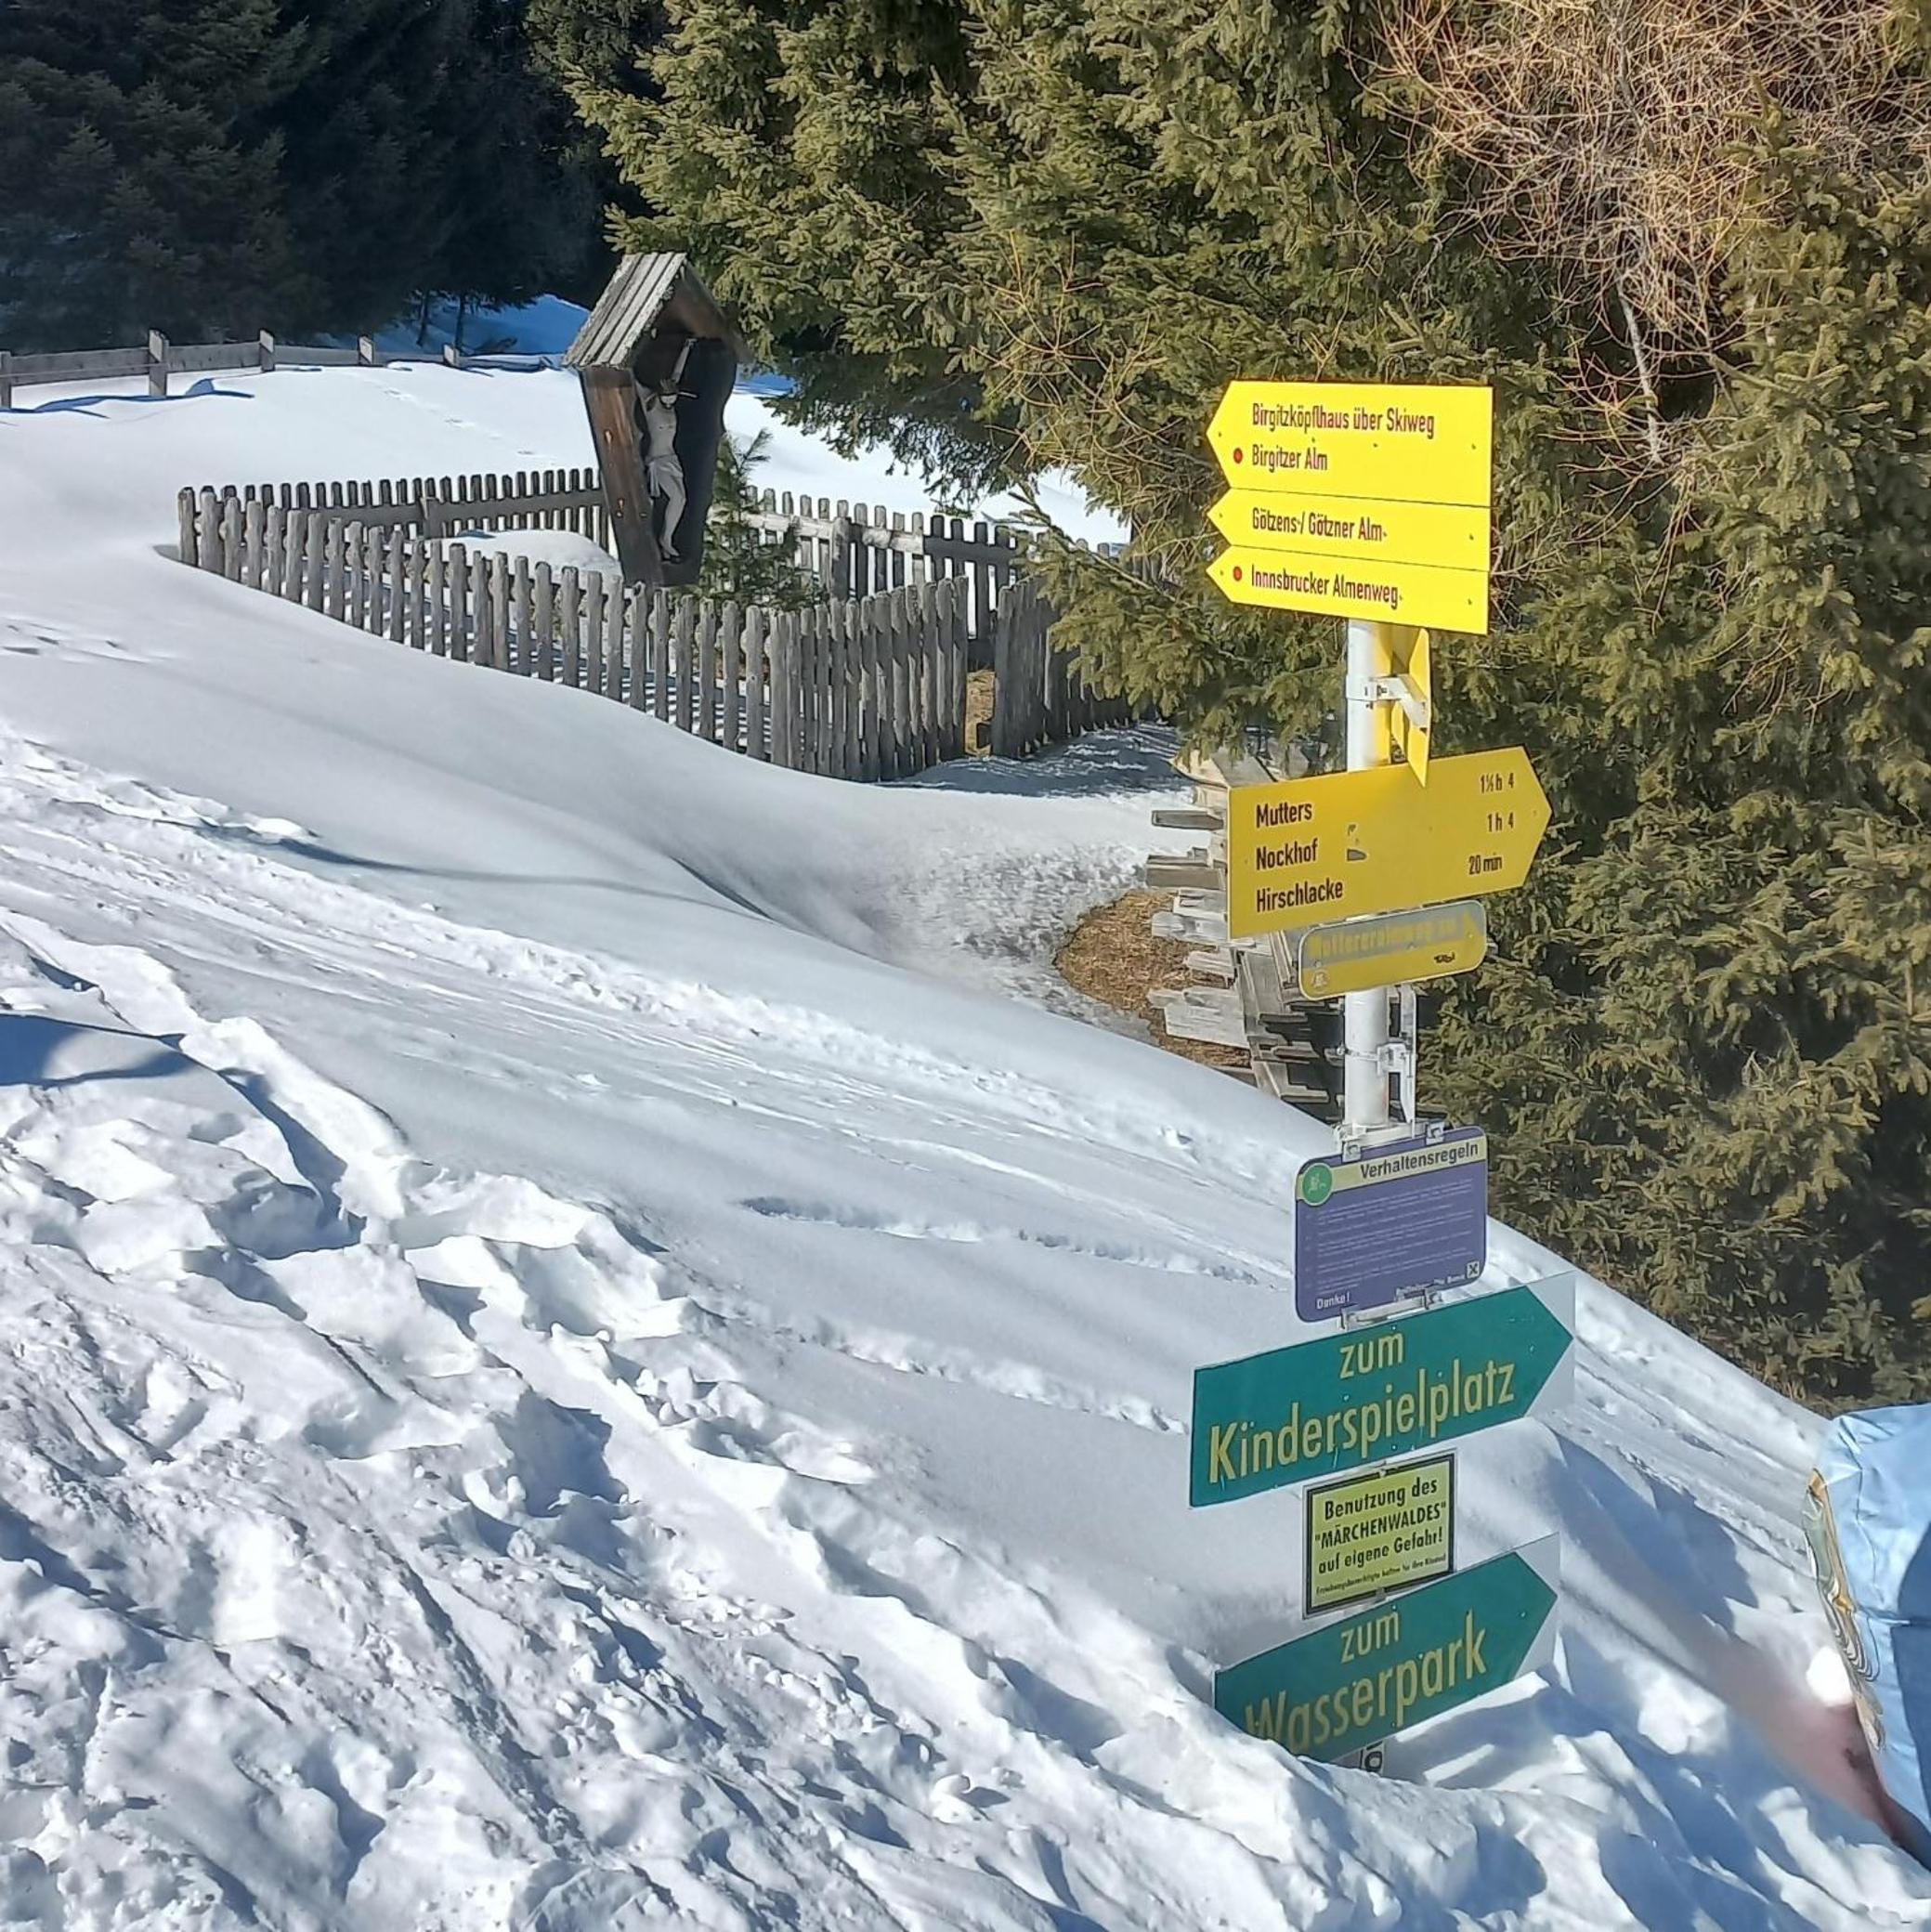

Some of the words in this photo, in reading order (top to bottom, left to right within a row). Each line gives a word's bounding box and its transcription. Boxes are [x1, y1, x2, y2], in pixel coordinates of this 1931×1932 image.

[1252, 402, 1350, 435] Birgitzköpflhaus
[1353, 408, 1383, 431] über
[1387, 407, 1435, 439] Skiweg
[1252, 443, 1301, 473] Birgitzer
[1304, 446, 1328, 471] Alm
[1309, 512, 1355, 539] Götzner
[1358, 516, 1383, 542] Alm
[1333, 579, 1399, 610] Almenweg
[1256, 801, 1313, 829] Mutters
[1256, 837, 1319, 871] Nockhof
[1256, 878, 1344, 913] Hirschlacke
[1468, 854, 1481, 875] 20
[1360, 1142, 1479, 1180] Verhaltensregeln
[1338, 1331, 1405, 1379] zum
[1208, 1358, 1516, 1484] Kinderspielplatz
[1324, 1486, 1406, 1521] Benutzung
[1411, 1476, 1438, 1497] des
[1318, 1552, 1340, 1574] auf
[1344, 1545, 1390, 1569] eigene
[1393, 1526, 1443, 1554] Gefahr!
[1340, 1610, 1400, 1664] zum
[1245, 1609, 1487, 1755] Wasserpark
